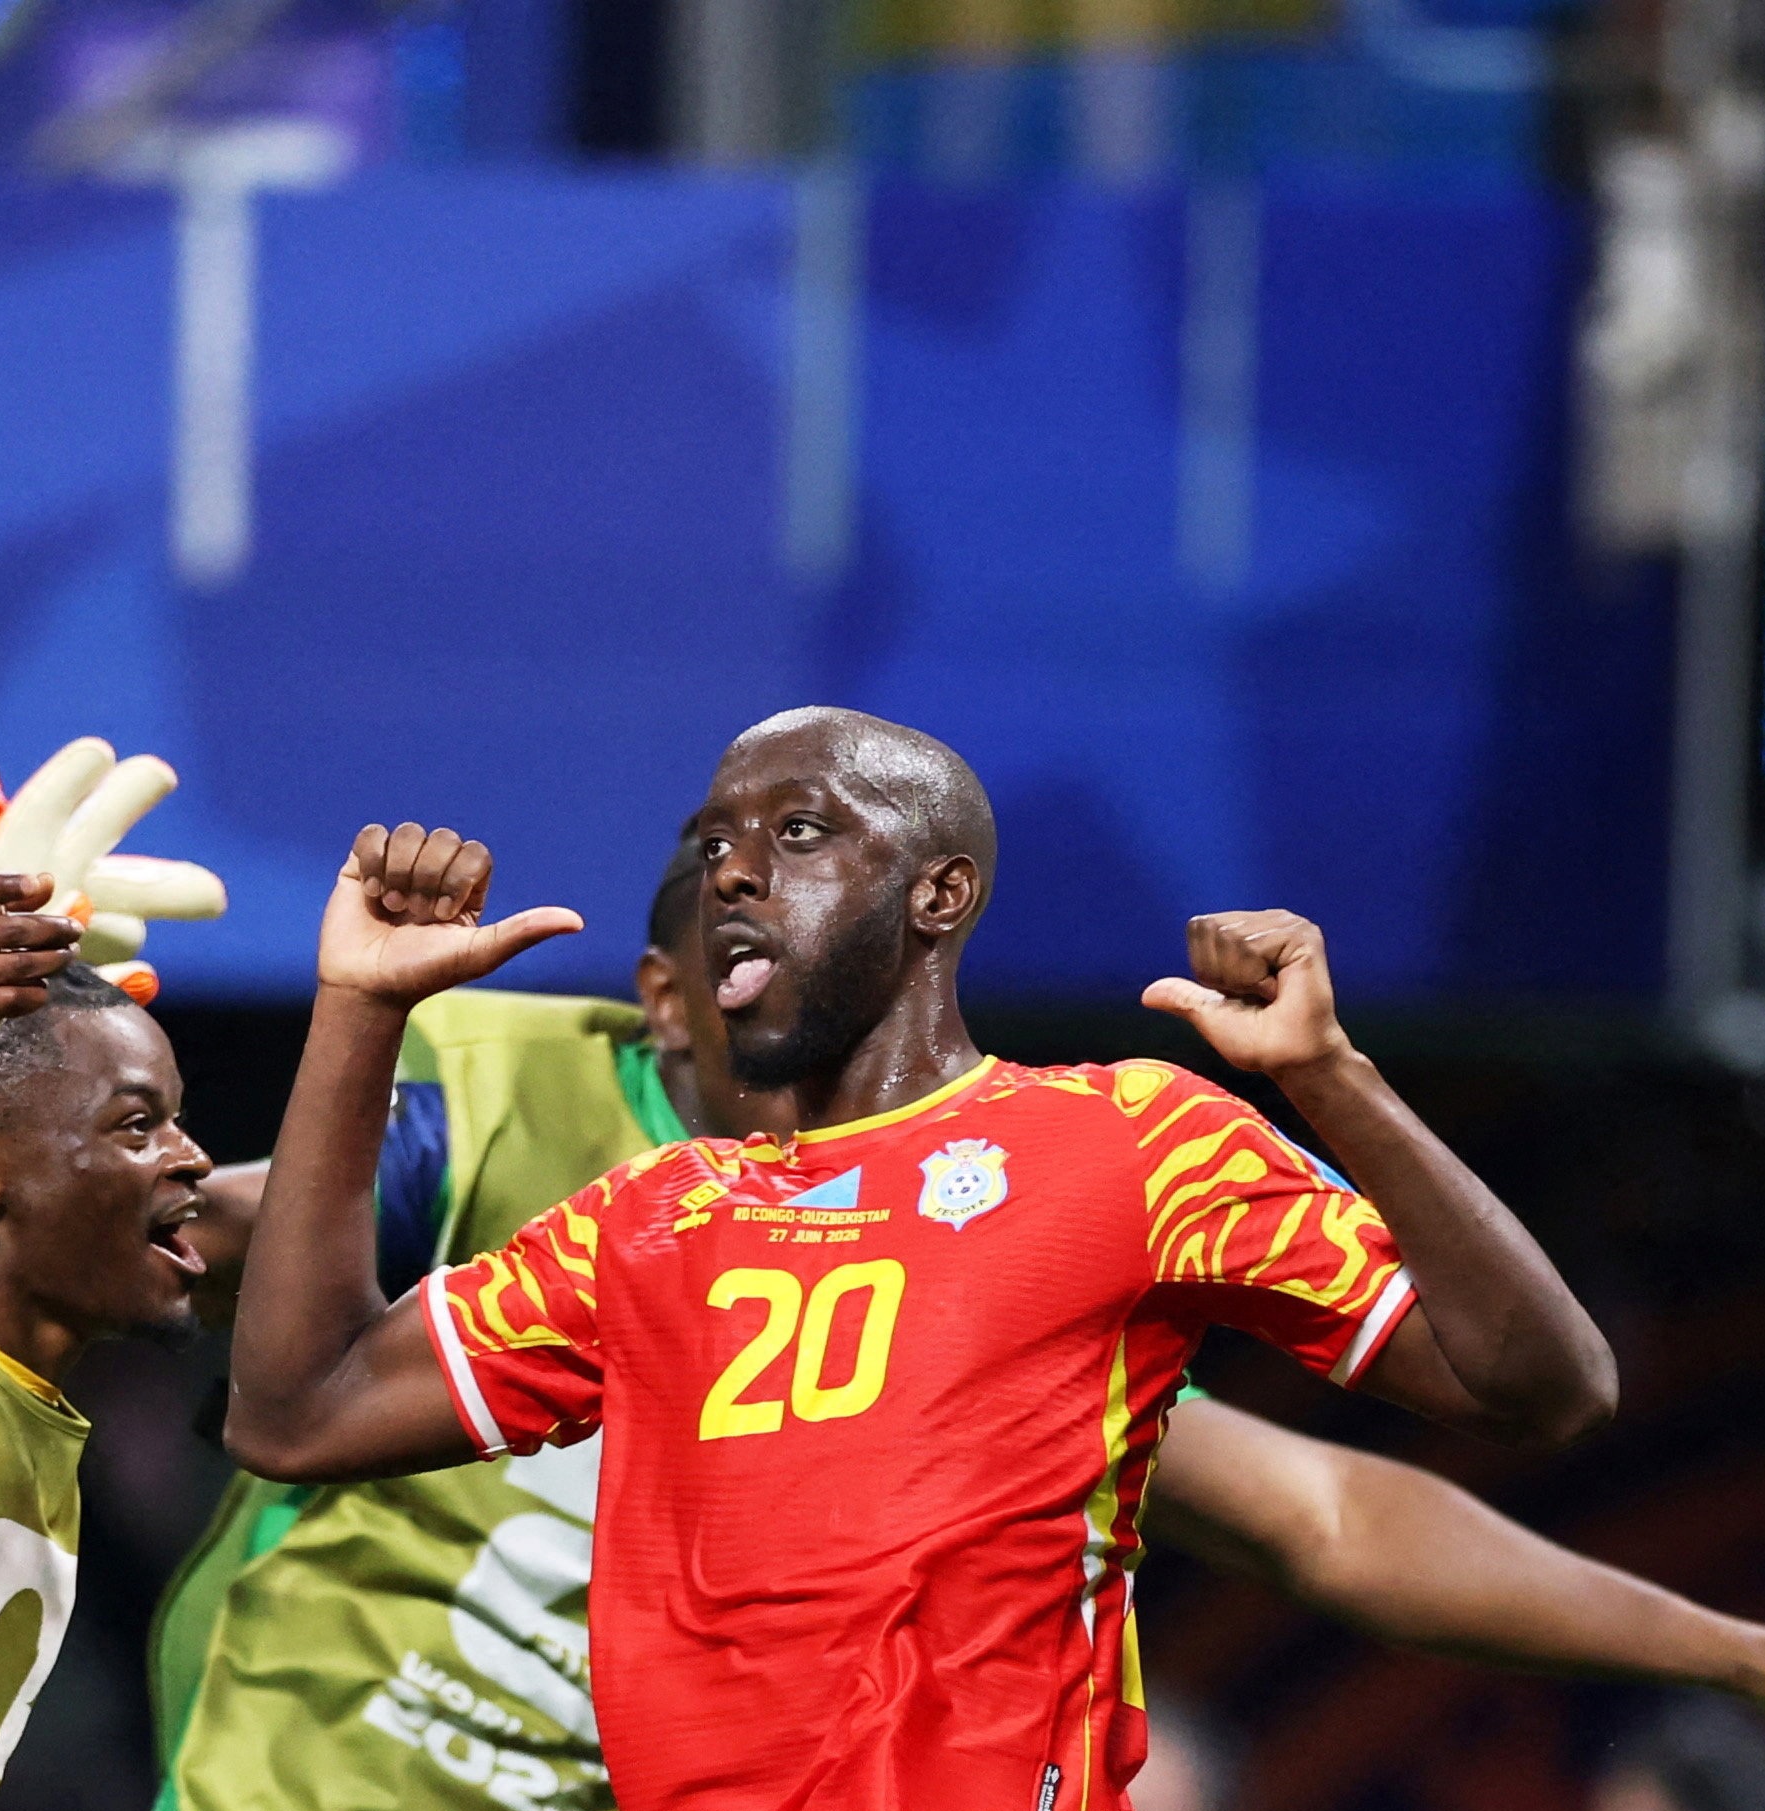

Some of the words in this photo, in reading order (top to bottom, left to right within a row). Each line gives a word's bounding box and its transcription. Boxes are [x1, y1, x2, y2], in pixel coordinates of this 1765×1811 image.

[733, 1207, 750, 1221] RD
[768, 1229, 788, 1243] 27
[790, 1230, 823, 1243] JUIN
[825, 1229, 861, 1243] 2026
[699, 1259, 906, 1441] 20
